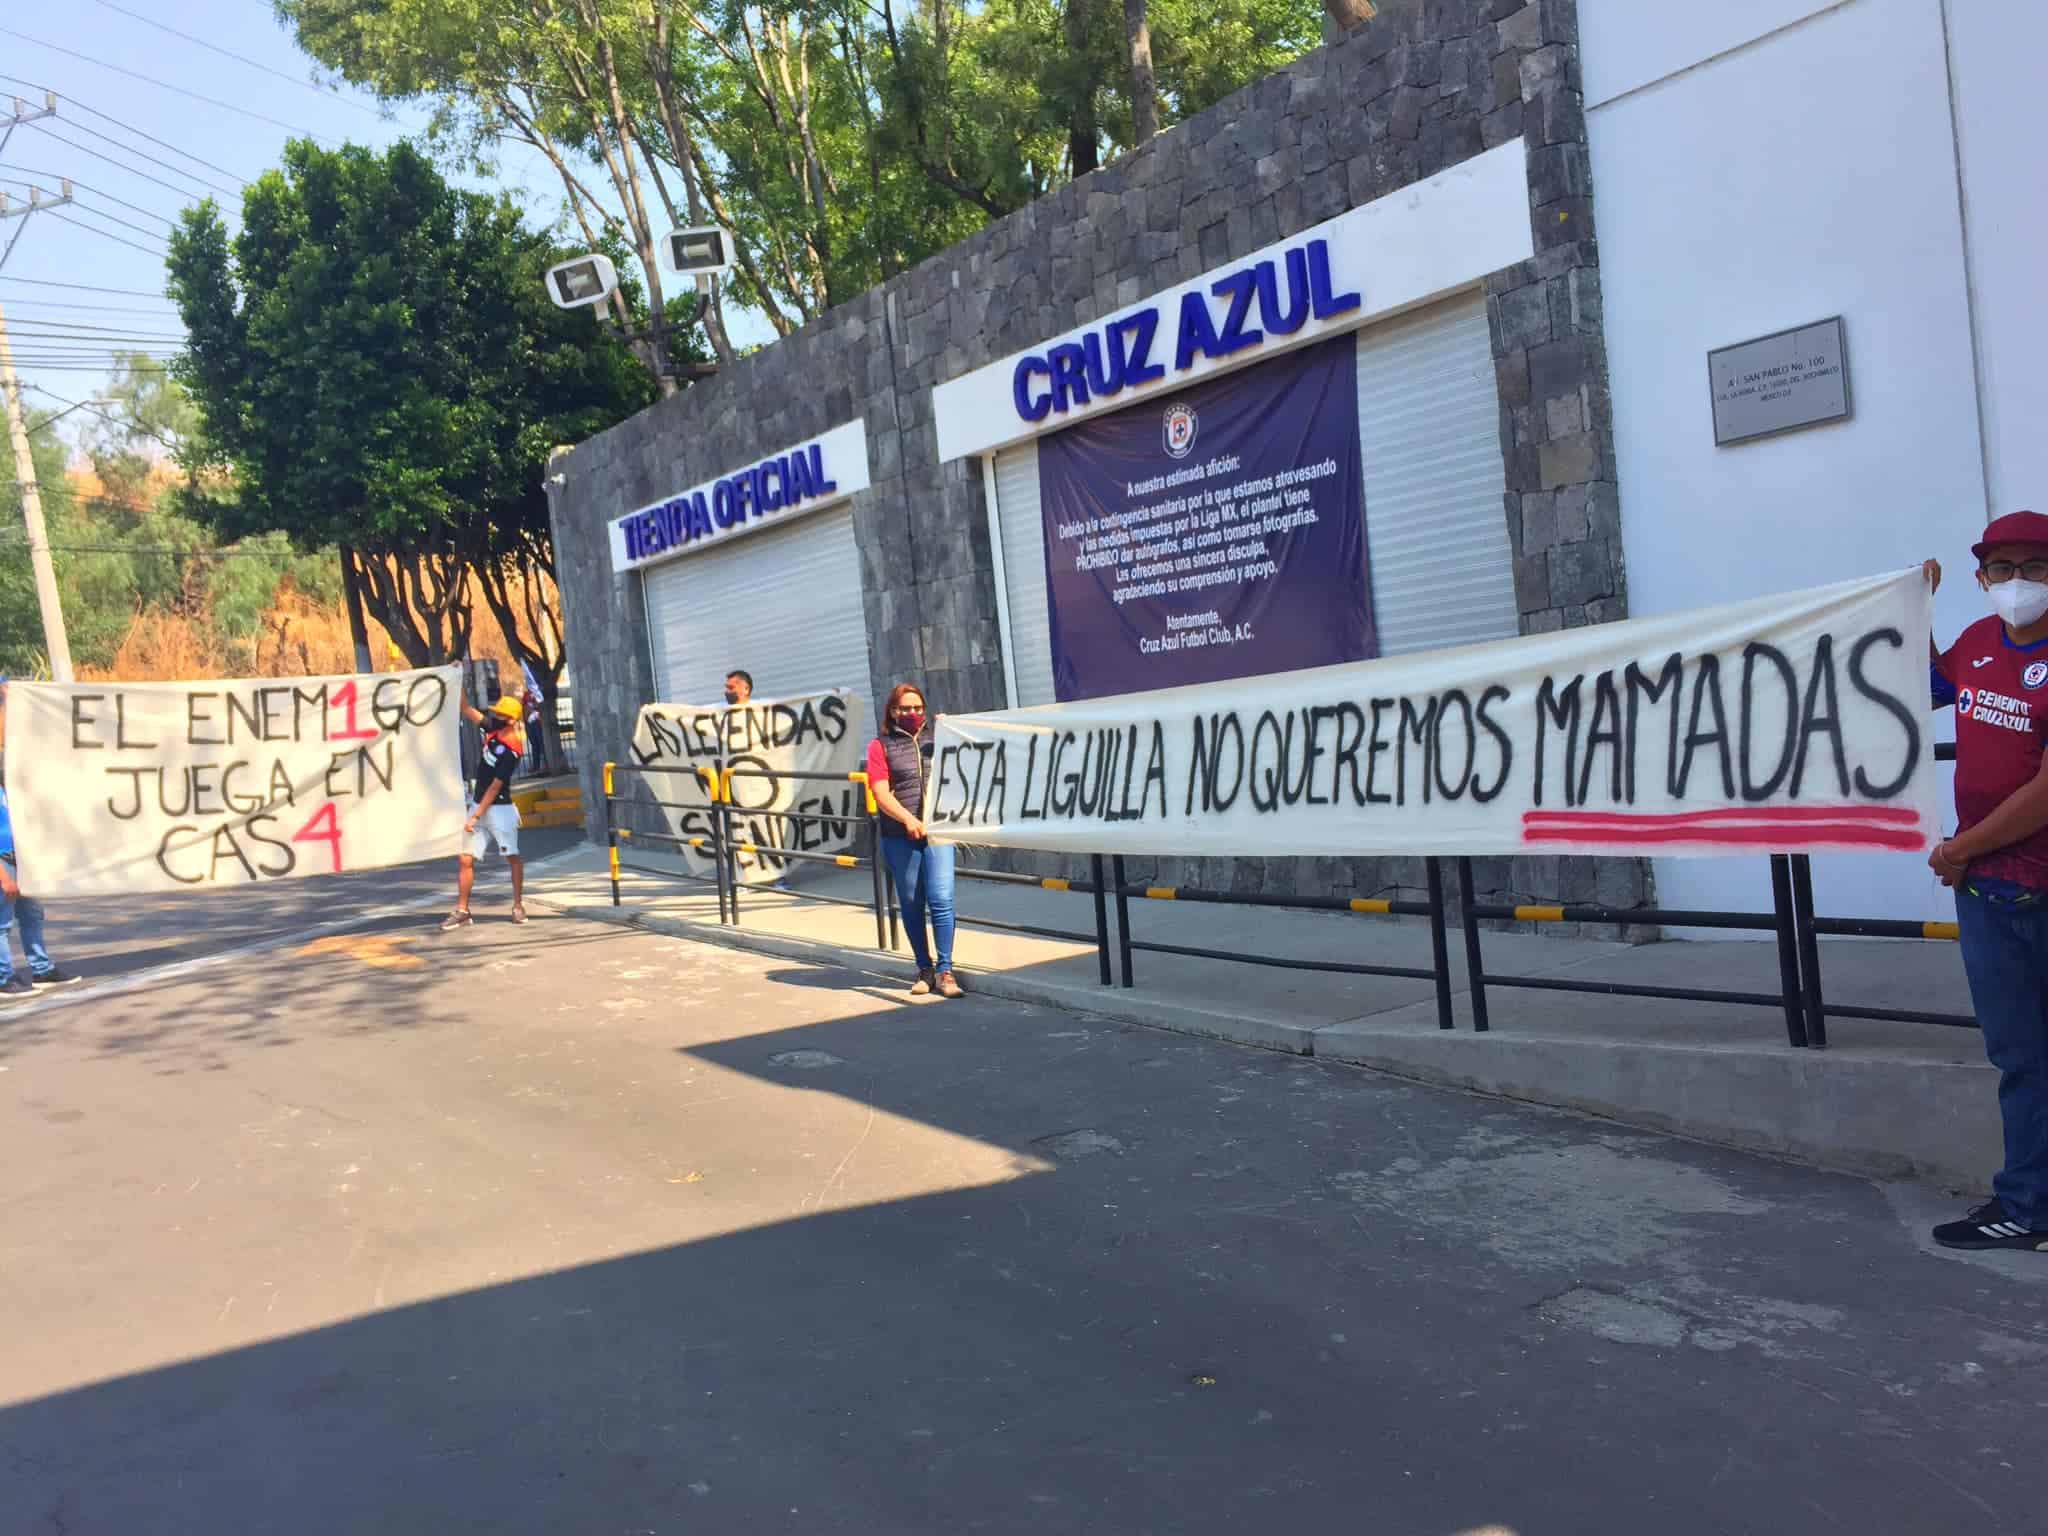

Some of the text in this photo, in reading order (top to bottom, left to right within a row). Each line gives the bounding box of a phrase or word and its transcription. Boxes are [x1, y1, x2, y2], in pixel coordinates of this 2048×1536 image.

[1013, 239, 1360, 422] CRUZ AZUL
[619, 444, 837, 560] TIENDA OFICIAL
[1059, 521, 1085, 540] Debido
[1100, 505, 1150, 531] contingencia
[1151, 497, 1186, 517] sanitaria
[1187, 494, 1203, 513] por
[1203, 488, 1213, 505] la
[1214, 487, 1232, 506] que
[1233, 476, 1274, 499] estamos
[1275, 457, 1337, 489] atravesando
[1127, 454, 1241, 498] A nuestra estimada afición:
[1076, 548, 1119, 572] PROHIBIDO
[1120, 546, 1134, 563] dar
[1196, 530, 1222, 549] como
[1222, 520, 1262, 543] tomarse
[1098, 520, 1130, 548] medidas
[1130, 521, 1173, 544] impuestas
[1174, 517, 1190, 537] por
[1190, 510, 1199, 529] la
[1200, 508, 1220, 529] Liga
[1221, 502, 1240, 523] MX,
[1240, 500, 1250, 518] el
[1251, 491, 1282, 520] plantel
[1283, 486, 1311, 507] tiene
[1112, 579, 1167, 605] agradeciendo
[1167, 578, 1178, 593] su
[1179, 564, 1236, 592] comprensión
[1236, 567, 1243, 584] y
[1130, 552, 1174, 580] ofrecemos
[1174, 557, 1193, 571] una
[1193, 549, 1226, 567] sincera
[1227, 540, 1270, 562] disculpa,
[1139, 621, 1255, 654] Cruz Azul Futbol Club, A.C.
[1166, 608, 1222, 631] Atentamente,
[72, 673, 447, 750] EL ENEM1GO
[632, 695, 847, 765] LAS LEYENDAS
[931, 627, 1921, 825] ESTA LIGUILLA NO QUEREMOS MAMADAS
[1976, 689, 2029, 716] CEMENTO
[105, 740, 394, 820] JUEGA EN
[155, 801, 343, 884] CAS4
